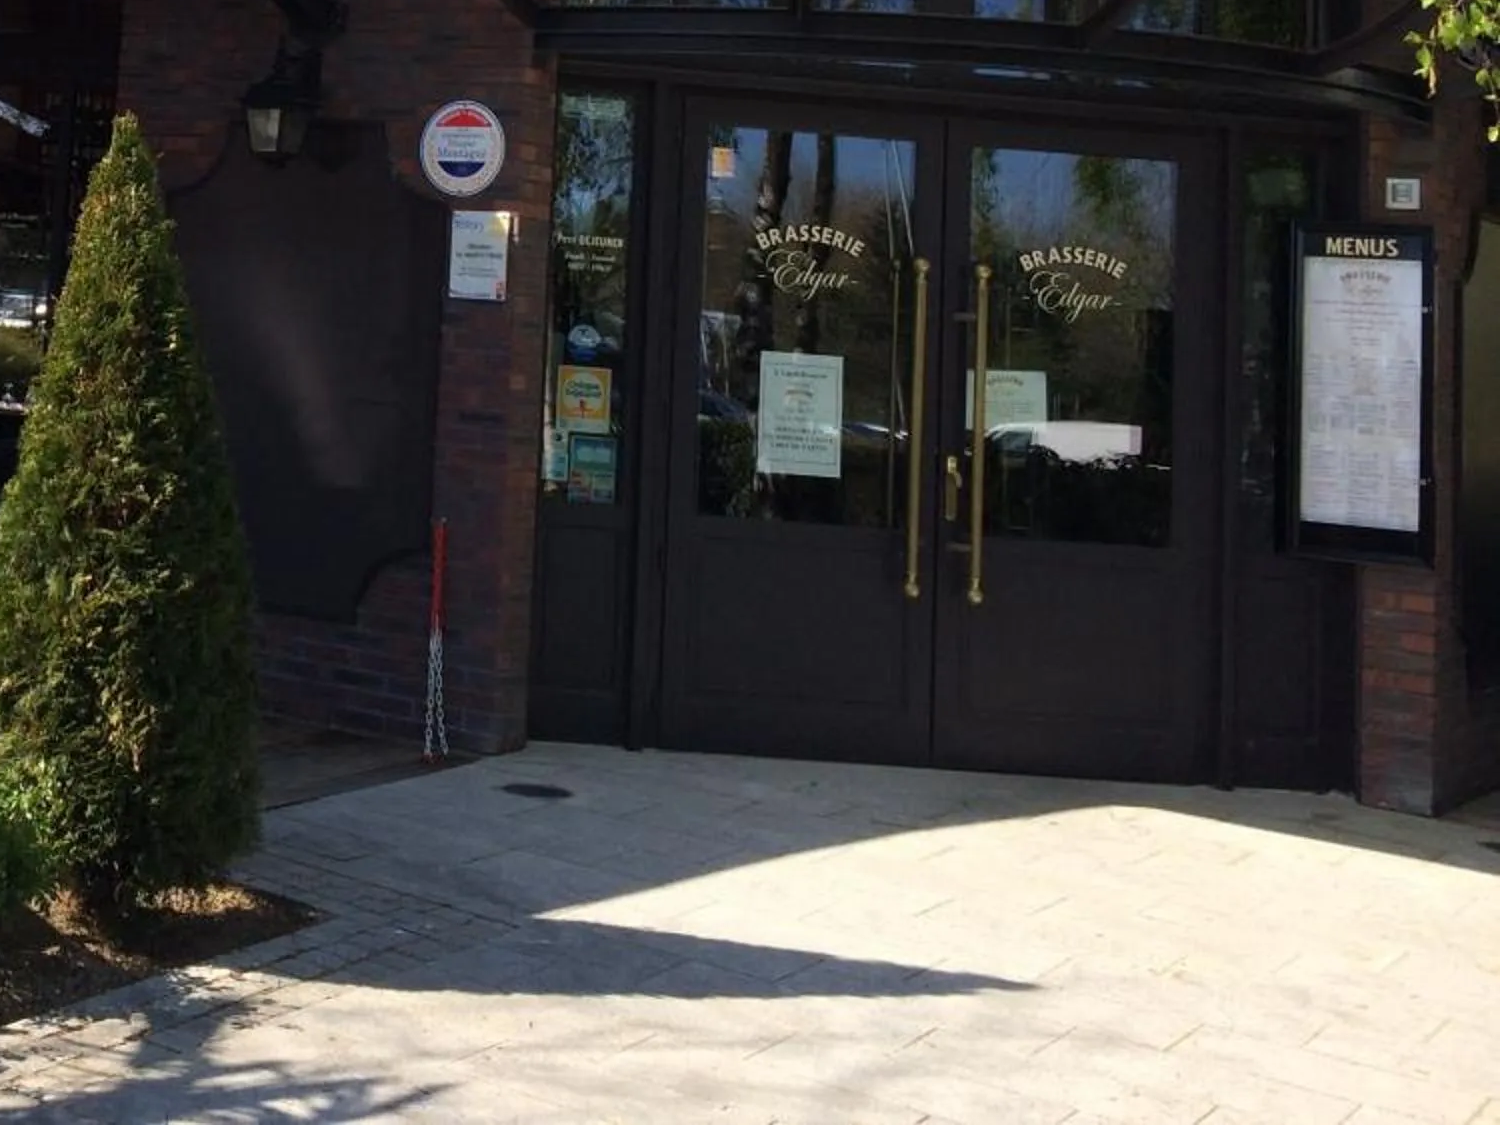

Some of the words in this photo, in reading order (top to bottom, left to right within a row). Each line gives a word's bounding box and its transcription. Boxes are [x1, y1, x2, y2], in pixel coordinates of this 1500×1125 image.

[756, 225, 866, 257] BRASSERIE
[1326, 237, 1400, 257] MENUS
[766, 250, 849, 302] Edgar
[1019, 247, 1129, 280] BRASSERIE
[1029, 271, 1113, 324] Edgar
